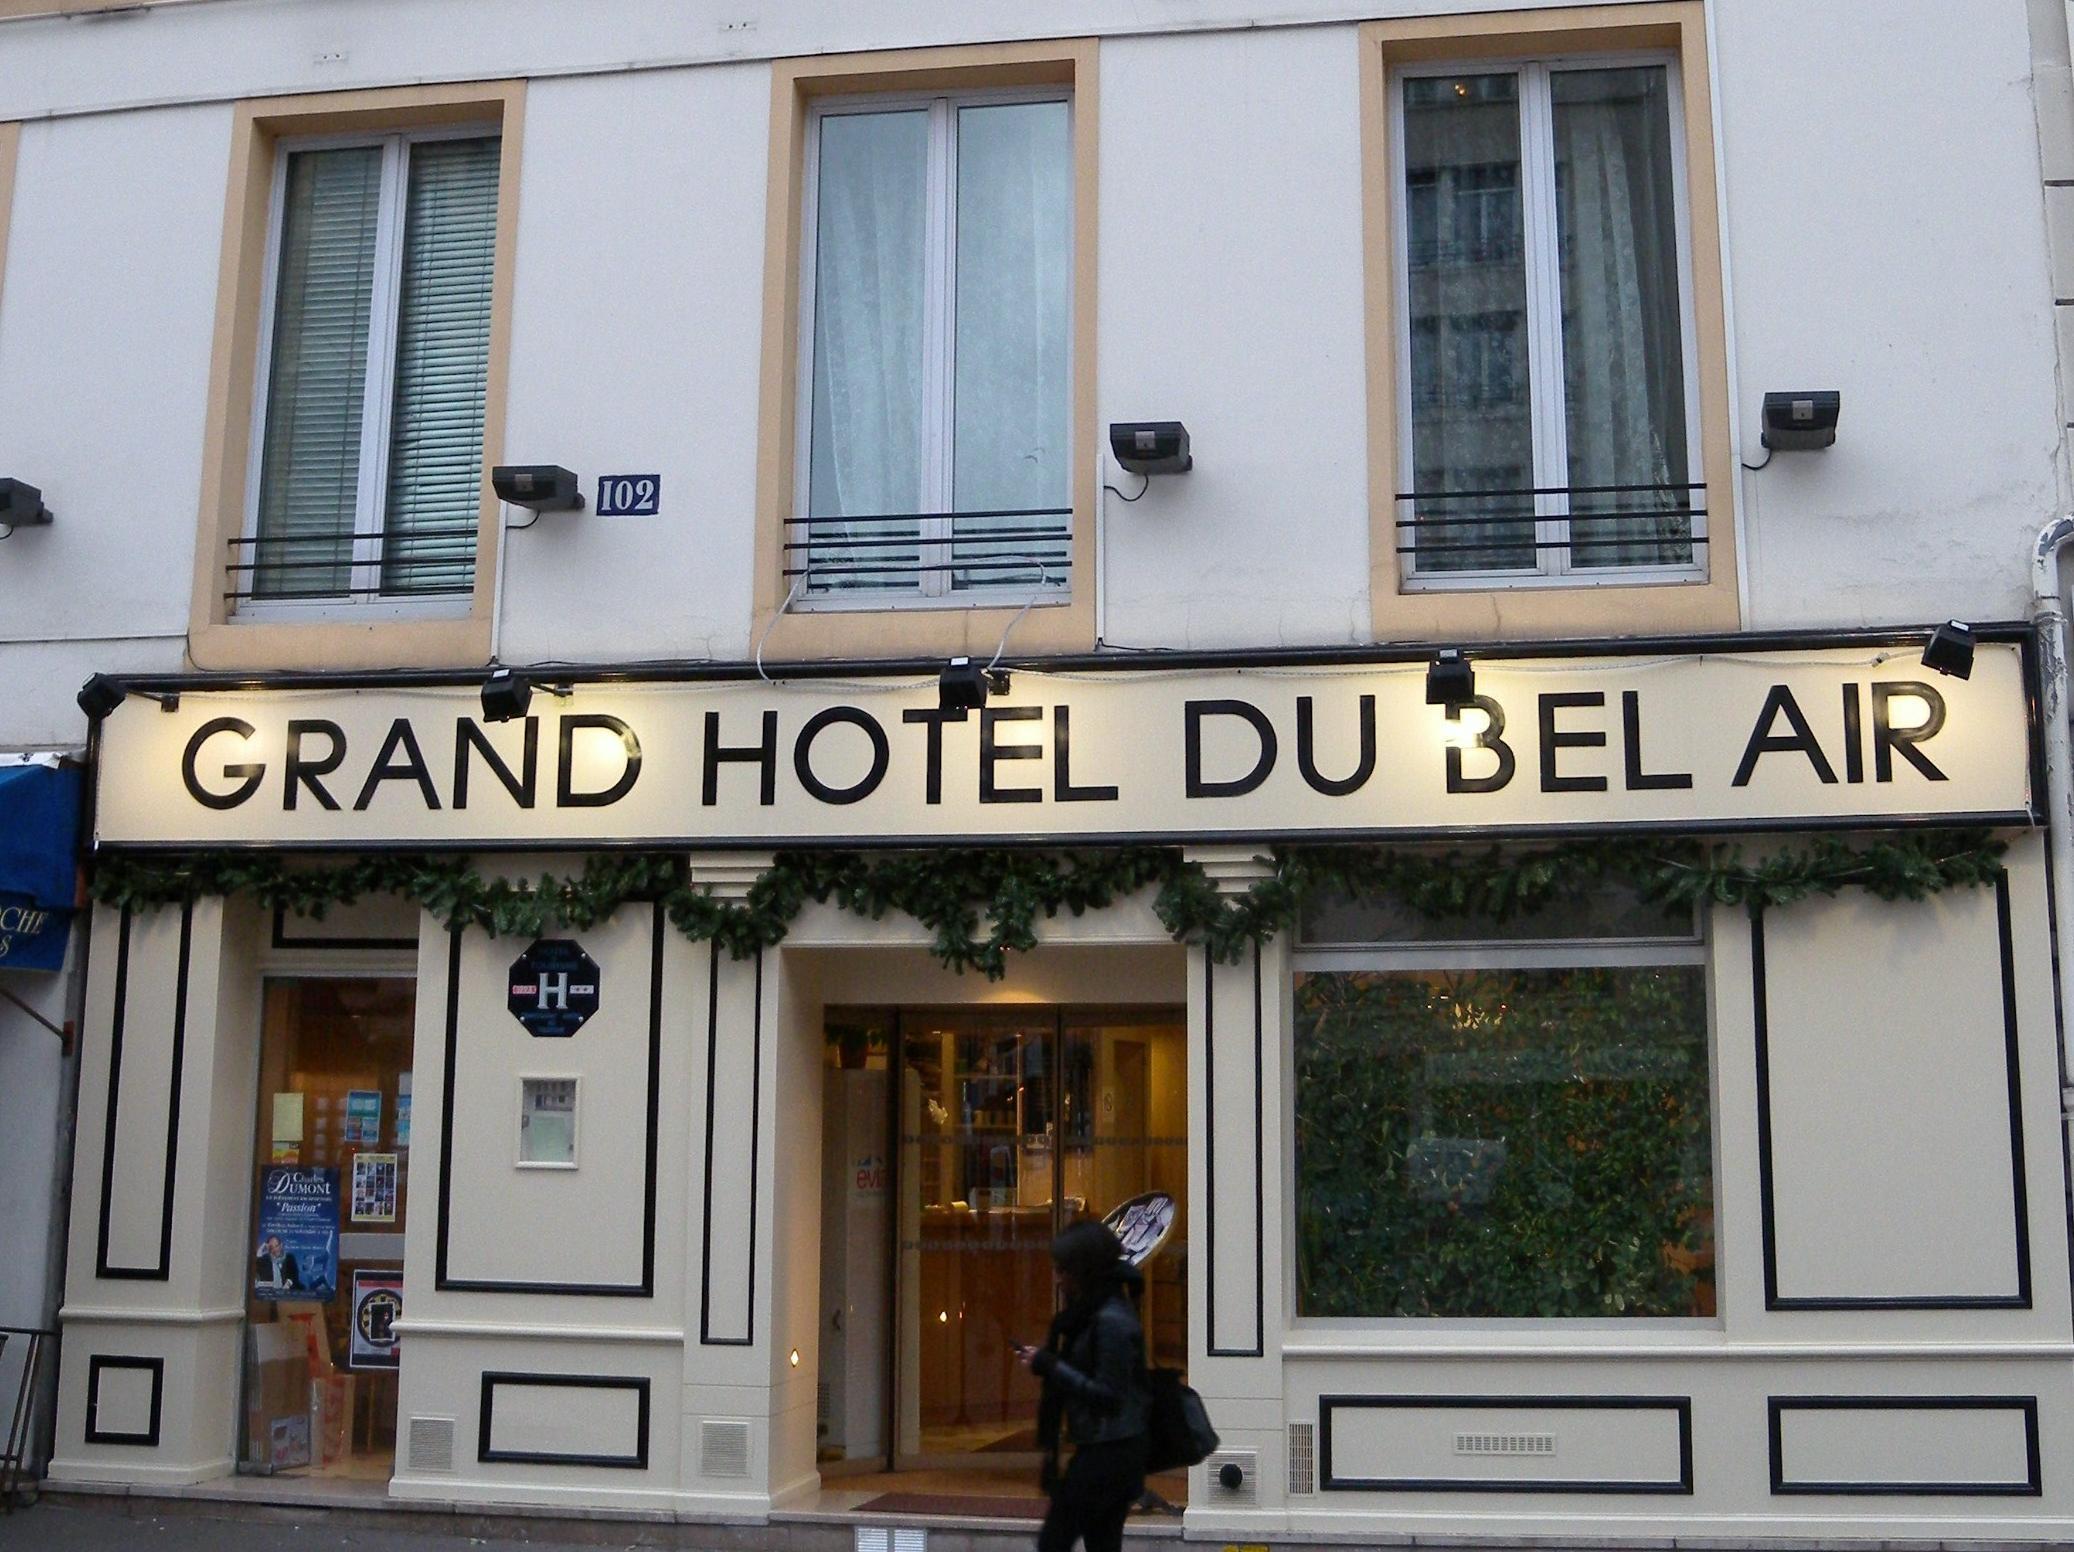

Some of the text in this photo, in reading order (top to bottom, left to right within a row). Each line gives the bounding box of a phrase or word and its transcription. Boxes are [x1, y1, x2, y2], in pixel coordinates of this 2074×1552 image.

[601, 480, 654, 510] 102
[181, 680, 1950, 811] GRAND HOTEL DU BEL AIR
[537, 972, 568, 1009] H
